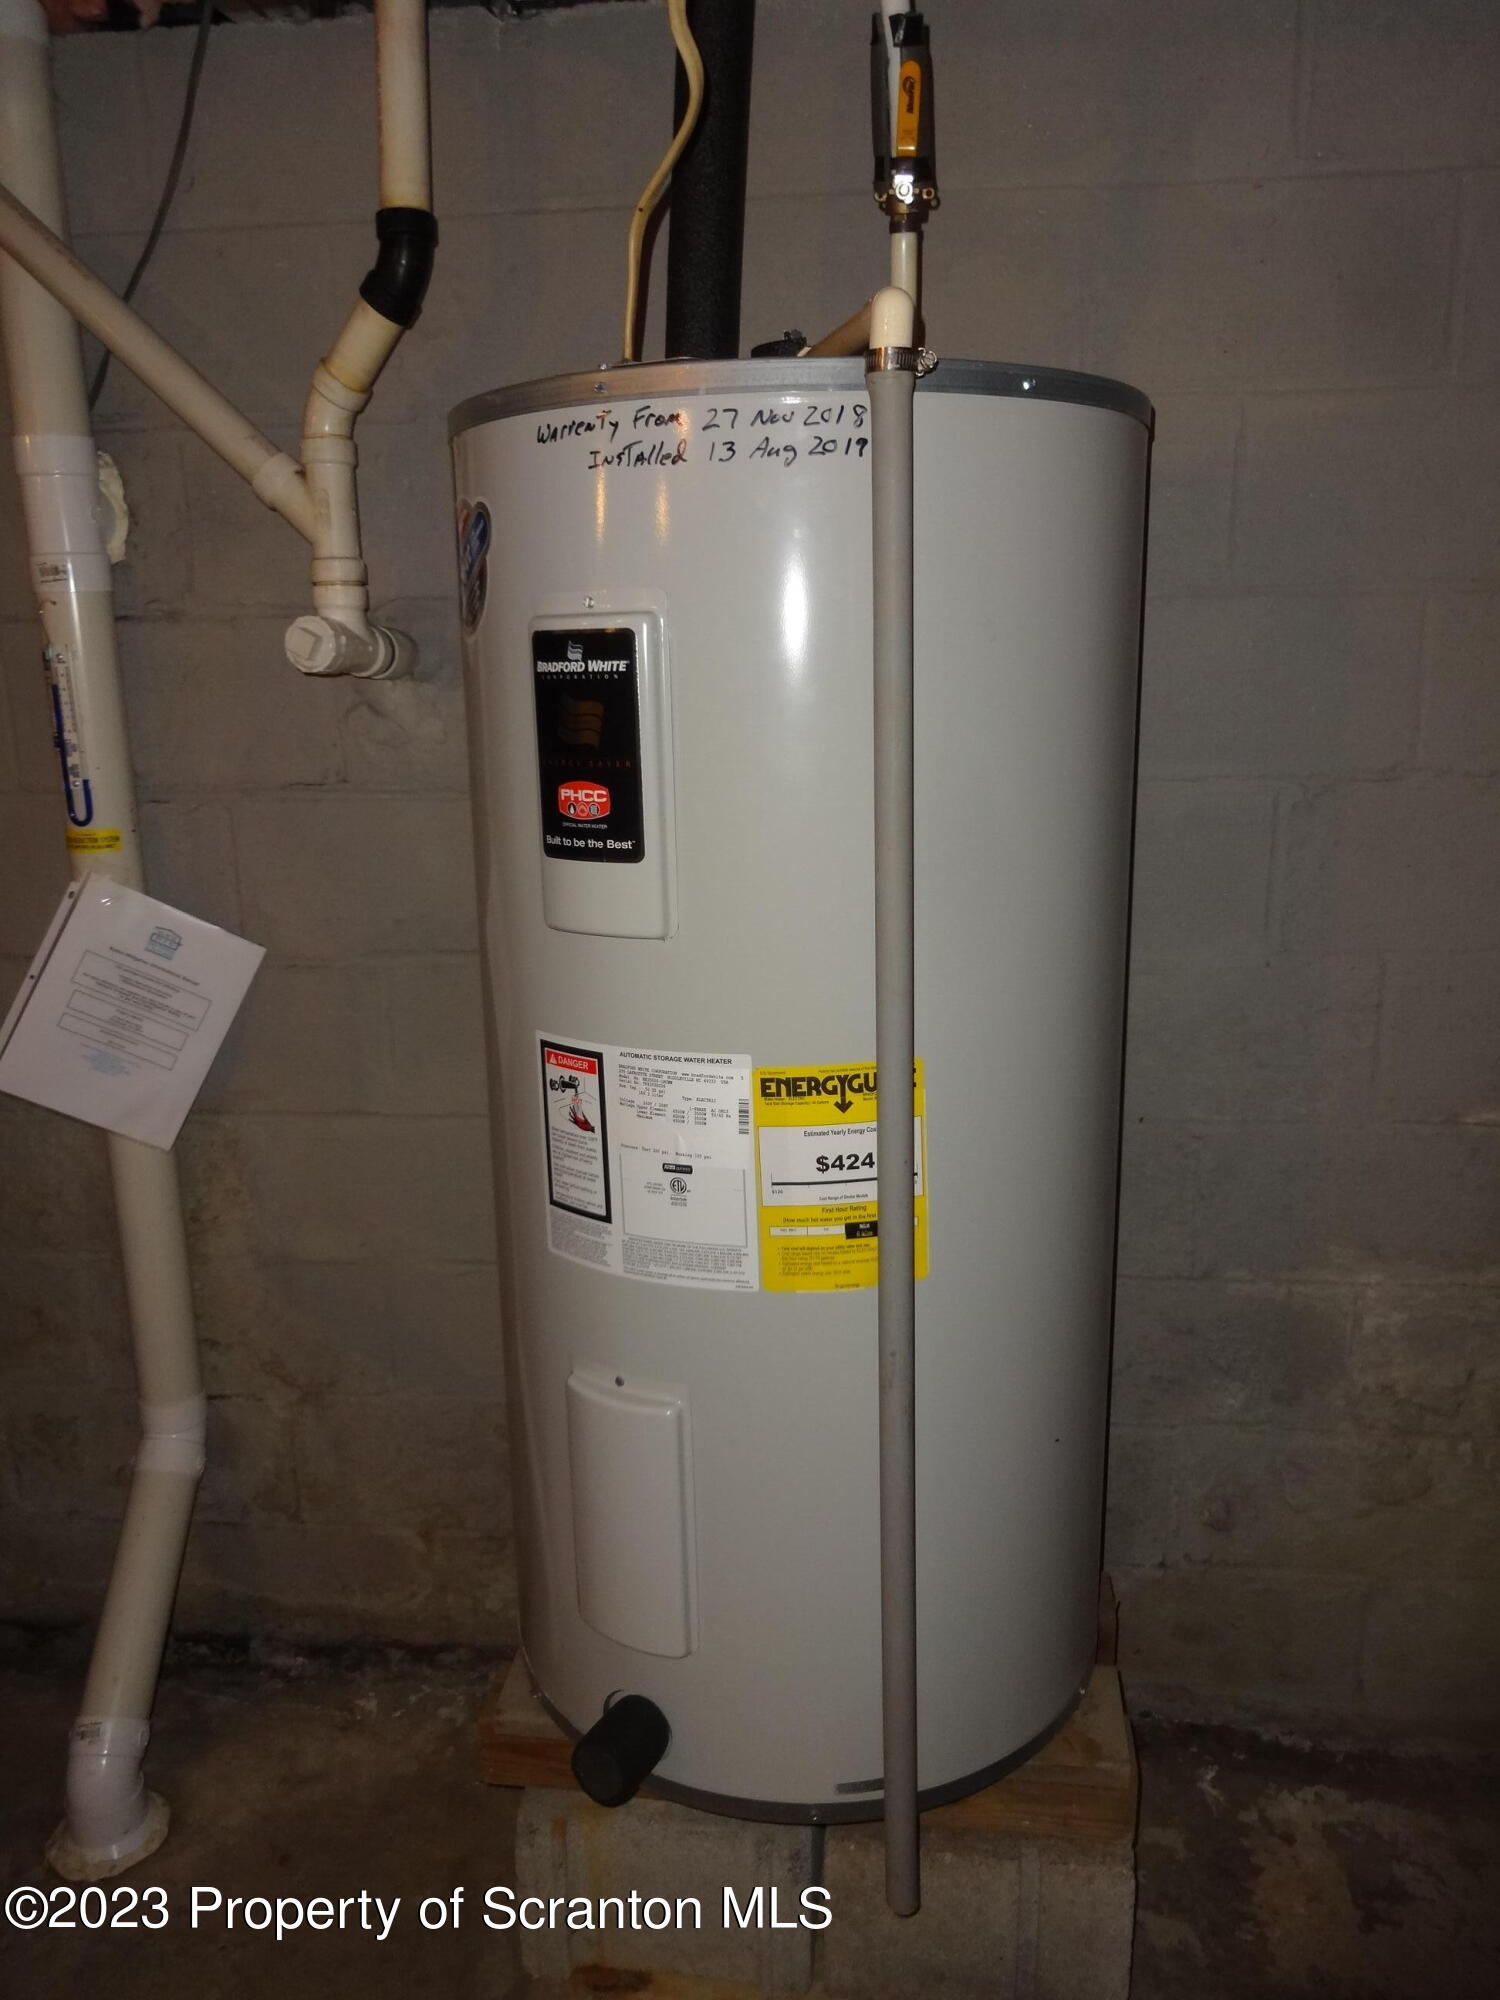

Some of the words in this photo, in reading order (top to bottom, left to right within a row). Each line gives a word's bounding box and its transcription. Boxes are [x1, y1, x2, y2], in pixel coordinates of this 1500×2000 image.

[702, 408, 738, 432] 27
[750, 408, 794, 427] Nov
[802, 404, 868, 429] 2018
[708, 441, 737, 463] 13
[749, 436, 798, 468] Aug
[808, 436, 869, 457] 2019
[537, 660, 586, 673] BRADFORD
[588, 659, 628, 673] WHITE
[560, 788, 609, 803] PHCC
[546, 834, 562, 846] Built
[562, 837, 572, 847] to
[573, 837, 586, 848] be
[587, 838, 604, 849] the
[606, 839, 633, 850] Best
[558, 1055, 589, 1070] DANGER
[619, 1051, 652, 1061] AUTOMATIC
[653, 1055, 683, 1064] STORAGE
[706, 1058, 733, 1066] HEATER
[803, 1129, 830, 1137] Estimated
[830, 1128, 846, 1137] Yearly
[847, 1127, 866, 1136] Energy
[816, 1152, 875, 1174] $424
[835, 1205, 849, 1213] Hour
[849, 1204, 867, 1213] Rating
